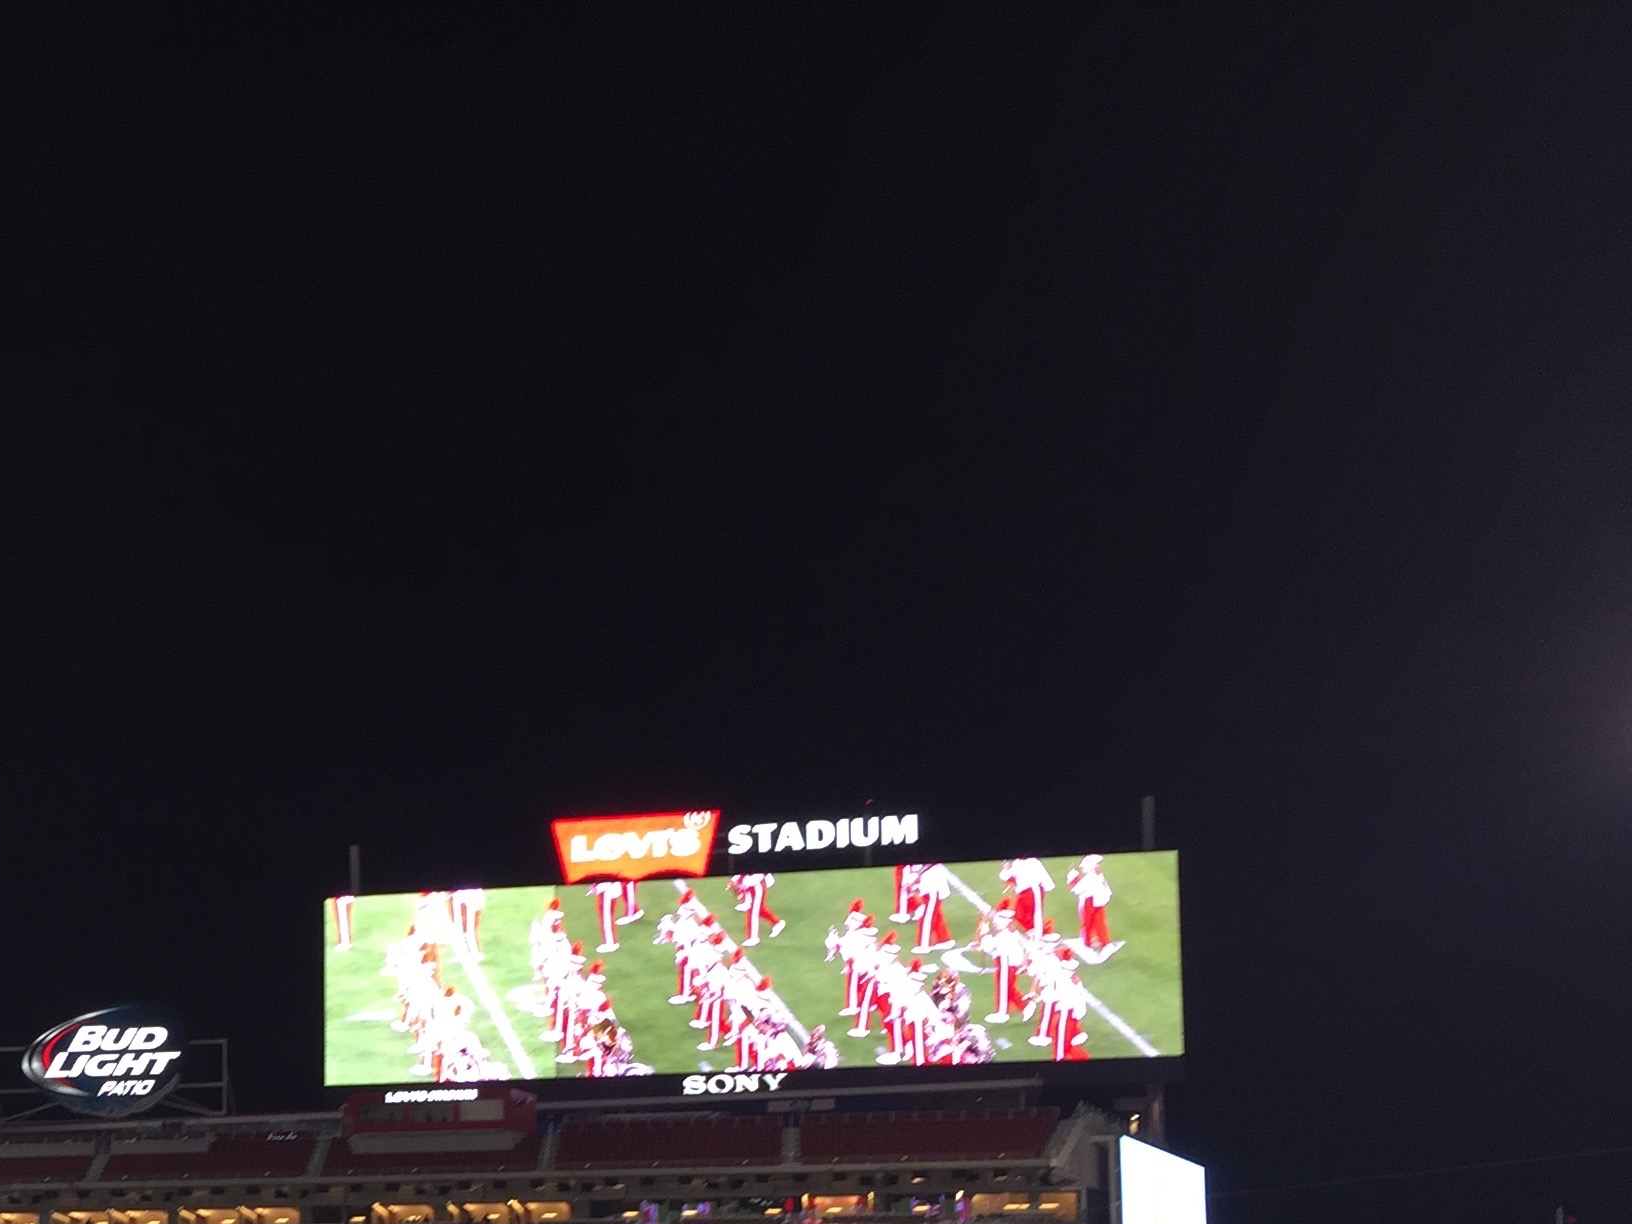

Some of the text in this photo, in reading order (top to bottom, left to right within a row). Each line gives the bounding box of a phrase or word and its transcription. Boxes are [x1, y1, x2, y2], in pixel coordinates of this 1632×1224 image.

[728, 814, 919, 855] STADIUM
[67, 1025, 169, 1053] BUD
[44, 1051, 182, 1079] LIGHT
[97, 1079, 157, 1097] PATIO
[682, 1073, 788, 1095] SONY
